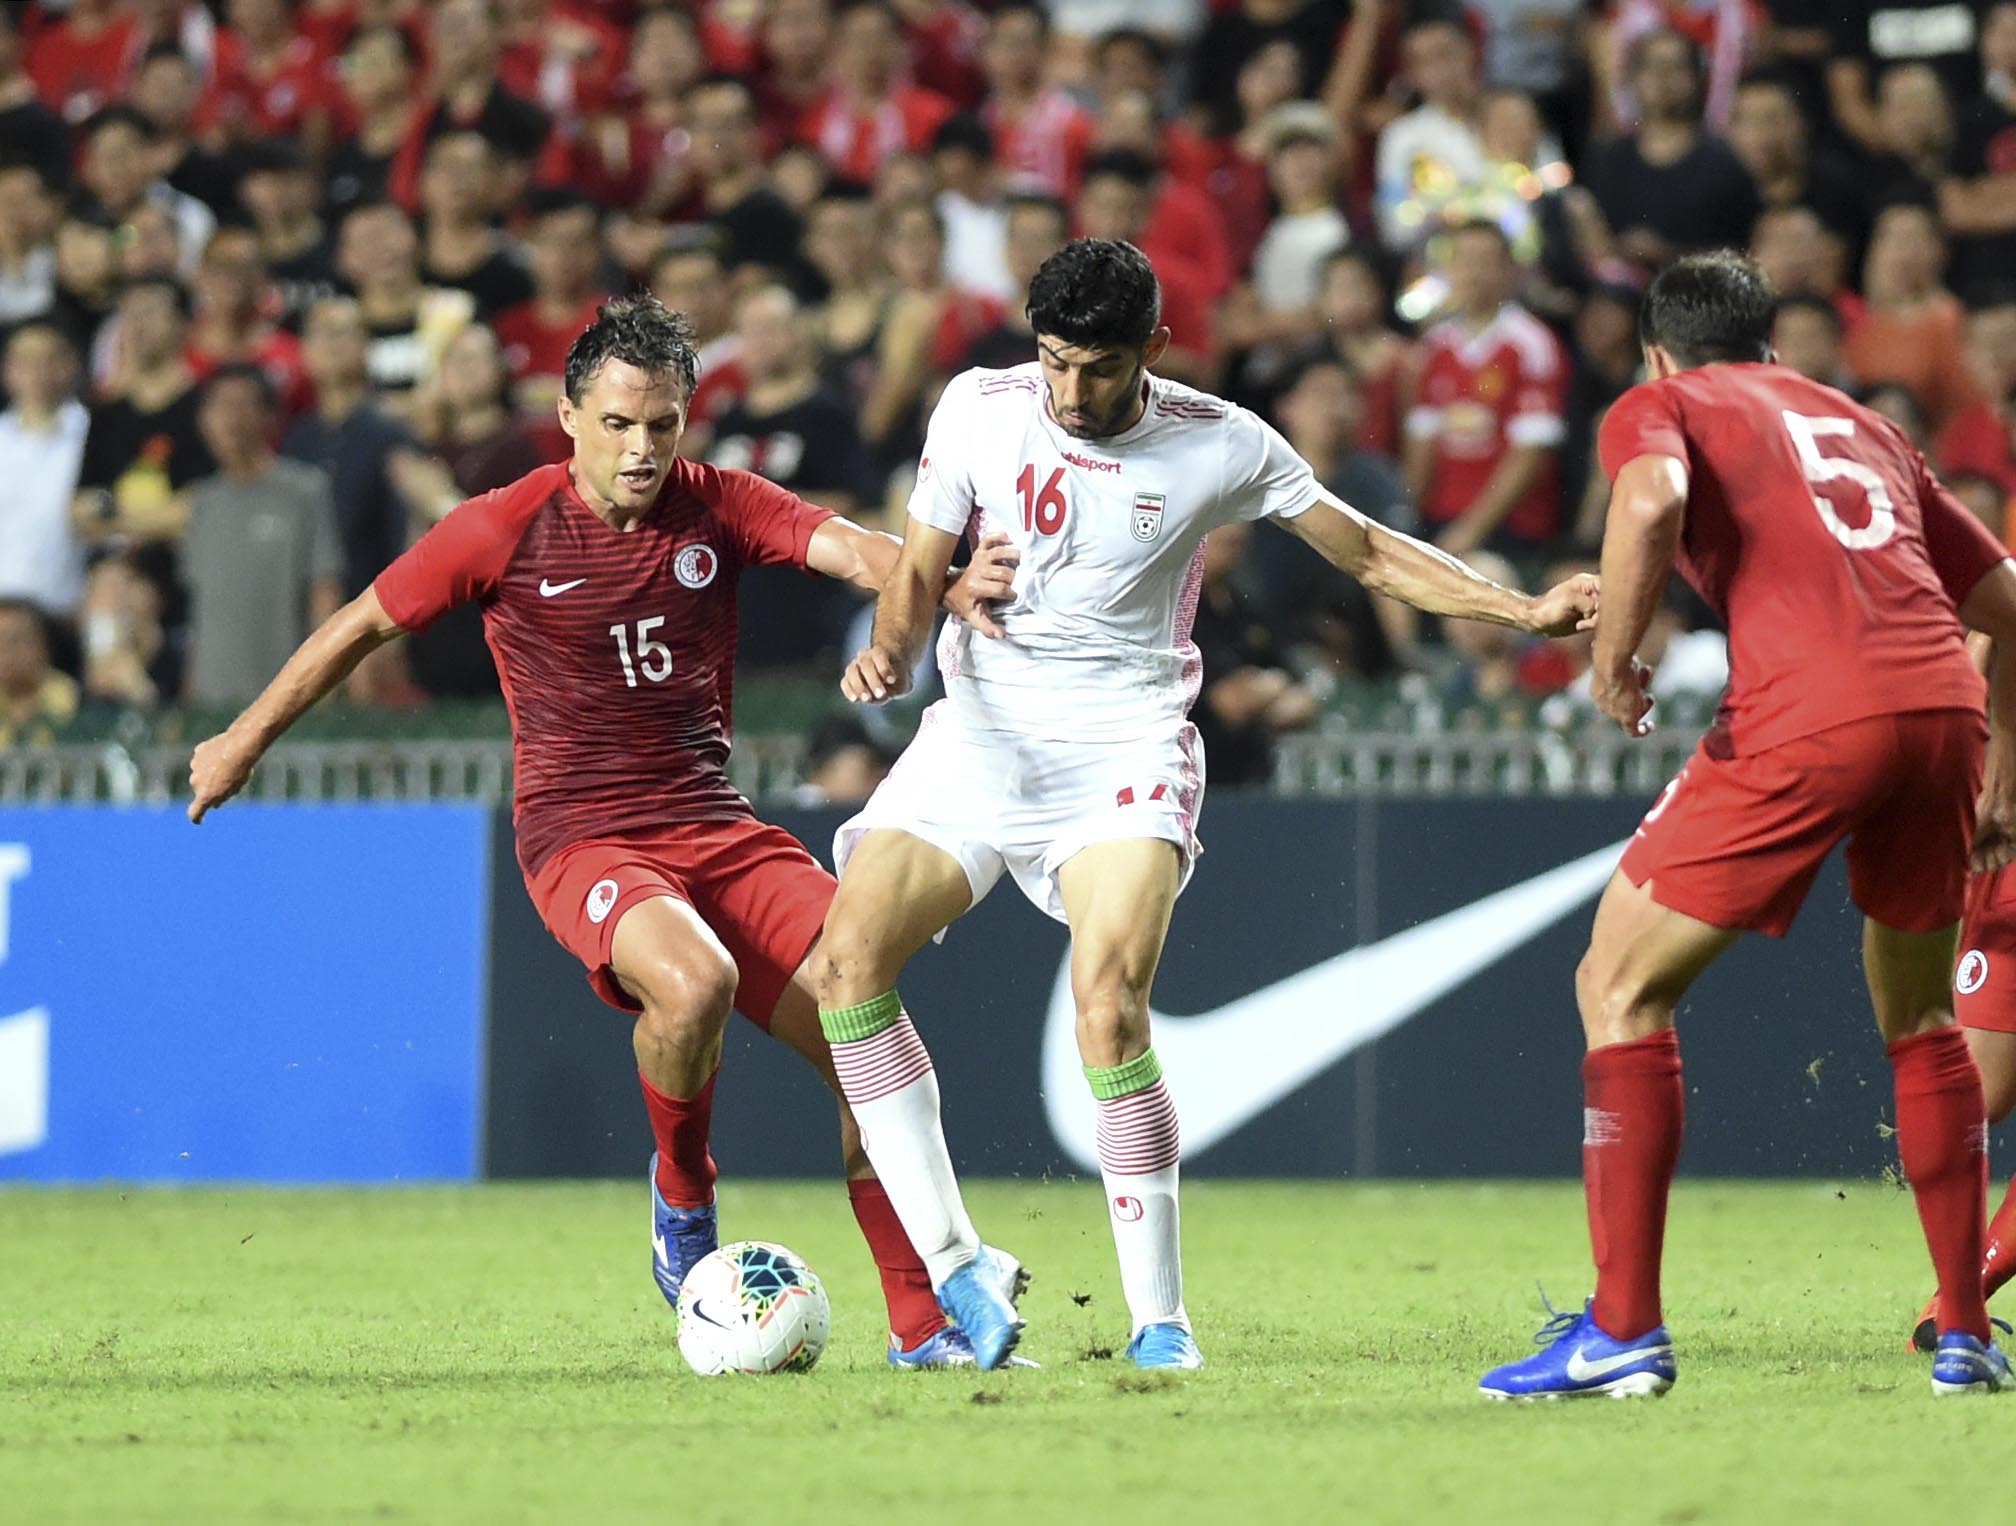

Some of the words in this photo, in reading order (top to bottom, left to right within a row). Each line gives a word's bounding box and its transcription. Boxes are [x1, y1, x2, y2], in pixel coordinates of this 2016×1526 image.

[1016, 463, 1067, 536] 16
[1782, 409, 1896, 550] 5
[609, 615, 673, 687] 15
